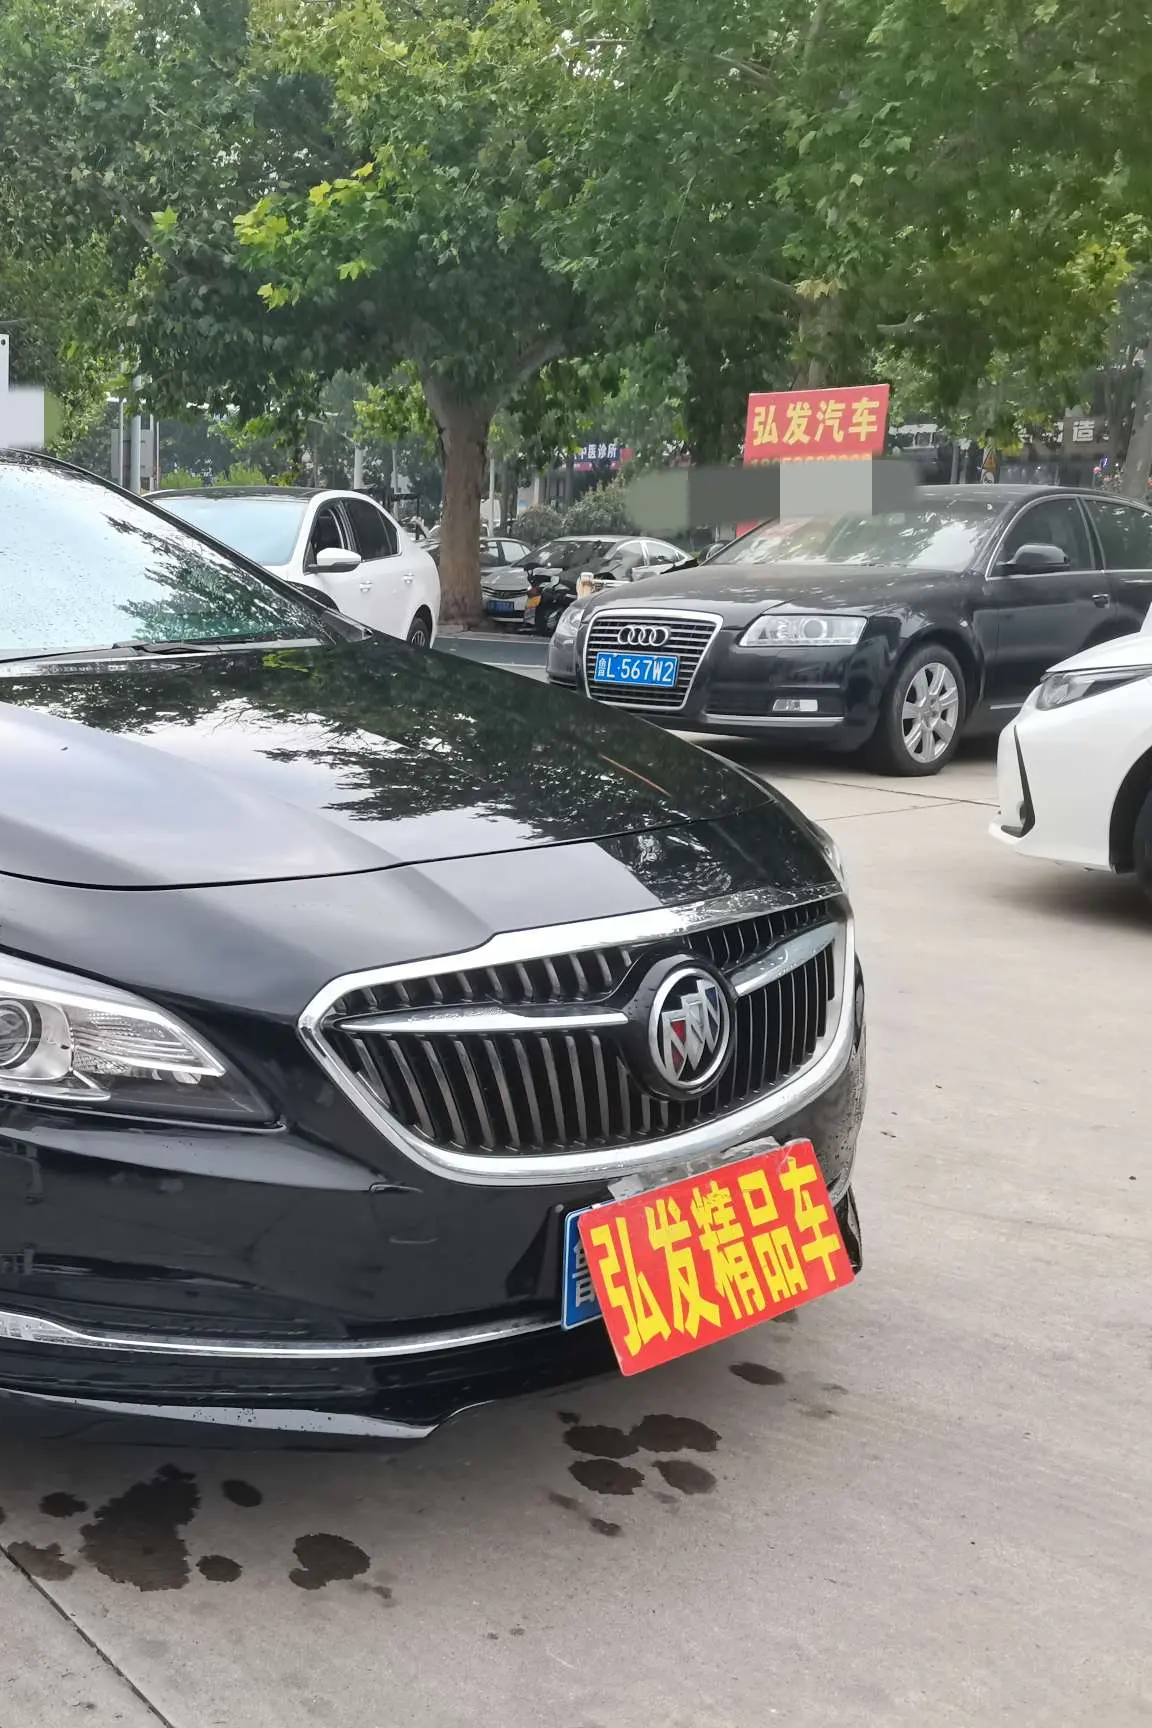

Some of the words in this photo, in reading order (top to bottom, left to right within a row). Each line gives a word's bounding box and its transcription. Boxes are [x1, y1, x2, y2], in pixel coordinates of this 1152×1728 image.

[752, 397, 880, 447] 弘发汽车
[590, 1155, 842, 1357] 弘发精品车
